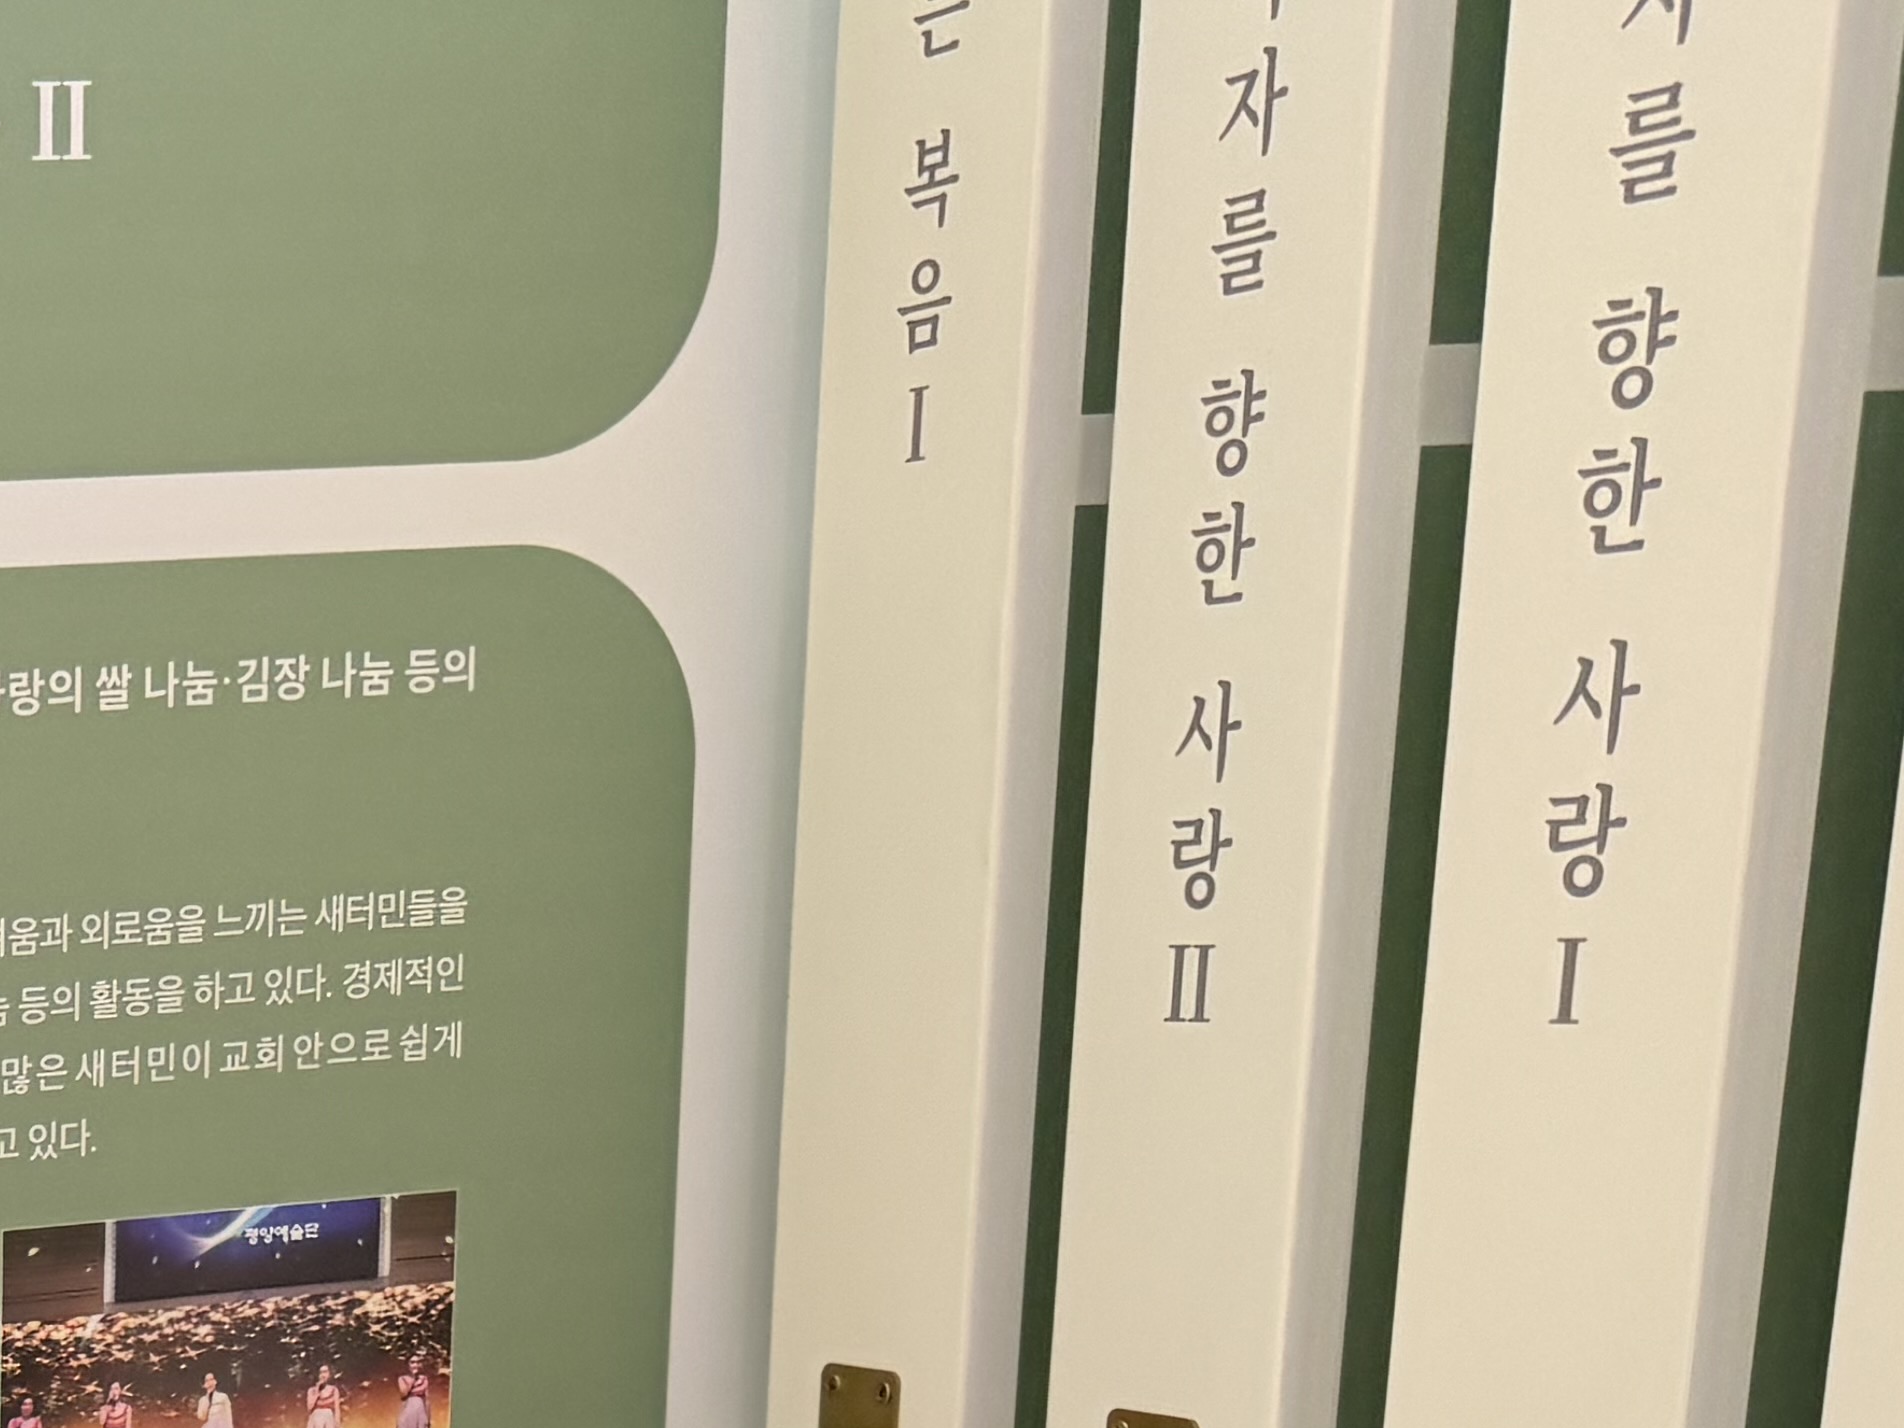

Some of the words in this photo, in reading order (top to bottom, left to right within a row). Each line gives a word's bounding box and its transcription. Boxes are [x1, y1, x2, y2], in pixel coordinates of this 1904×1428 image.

[896, 128, 961, 355] 복음
[1210, 0, 1289, 297] 자를
[1192, 368, 1268, 607] 향한
[1575, 286, 1680, 556] 향한
[94, 662, 133, 711] 쌀
[321, 650, 394, 698] 나눔
[403, 645, 476, 694] 등의
[1543, 637, 1642, 899] 사랑
[1169, 679, 1243, 911] 사랑
[17, 980, 80, 1025] 등의
[88, 974, 185, 1019] 활동을
[192, 969, 256, 1010] 하고
[263, 962, 332, 1006] 있다.
[342, 952, 463, 999] 경제적인
[79, 903, 206, 950] 외로움을
[212, 897, 308, 938] 느끼는
[313, 885, 468, 933] 새터민들을
[0, 1052, 68, 1095] 많은
[74, 1038, 210, 1088] 새터민이
[218, 1033, 284, 1073] 교회
[292, 1027, 392, 1070] 안으로
[398, 1019, 462, 1062] 쉽게
[27, 1117, 97, 1161] 있다.
